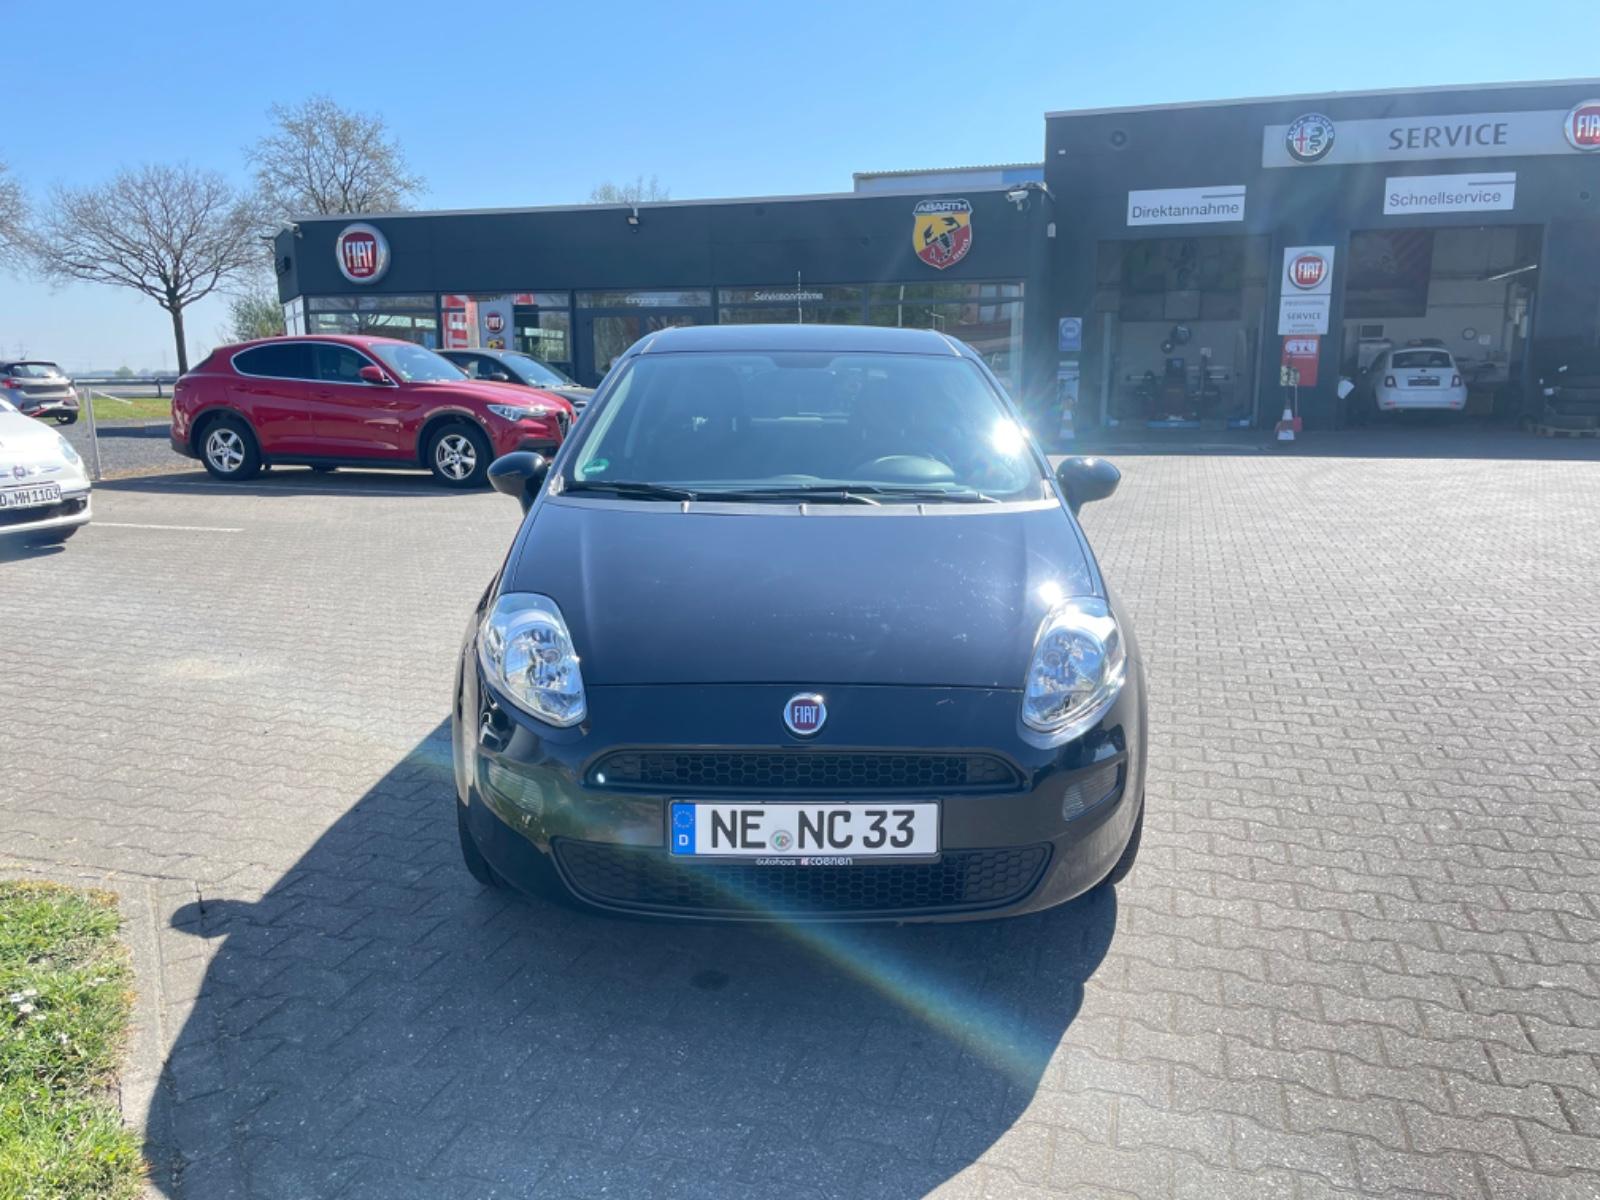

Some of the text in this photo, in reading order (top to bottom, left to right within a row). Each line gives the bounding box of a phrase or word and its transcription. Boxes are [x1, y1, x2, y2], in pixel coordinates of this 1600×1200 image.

[1576, 114, 1600, 138] FIA
[1388, 123, 1509, 150] SERVICE
[917, 202, 967, 212] ABARTH
[1389, 189, 1502, 208] Schnellservice
[1131, 202, 1240, 219] Direktannahme
[345, 240, 374, 268] FIAT
[1297, 261, 1322, 280] FIAT
[794, 705, 818, 724] FIAT
[711, 810, 915, 849] NE NC 33
[678, 834, 689, 847] D
[755, 857, 796, 866] autohaus
